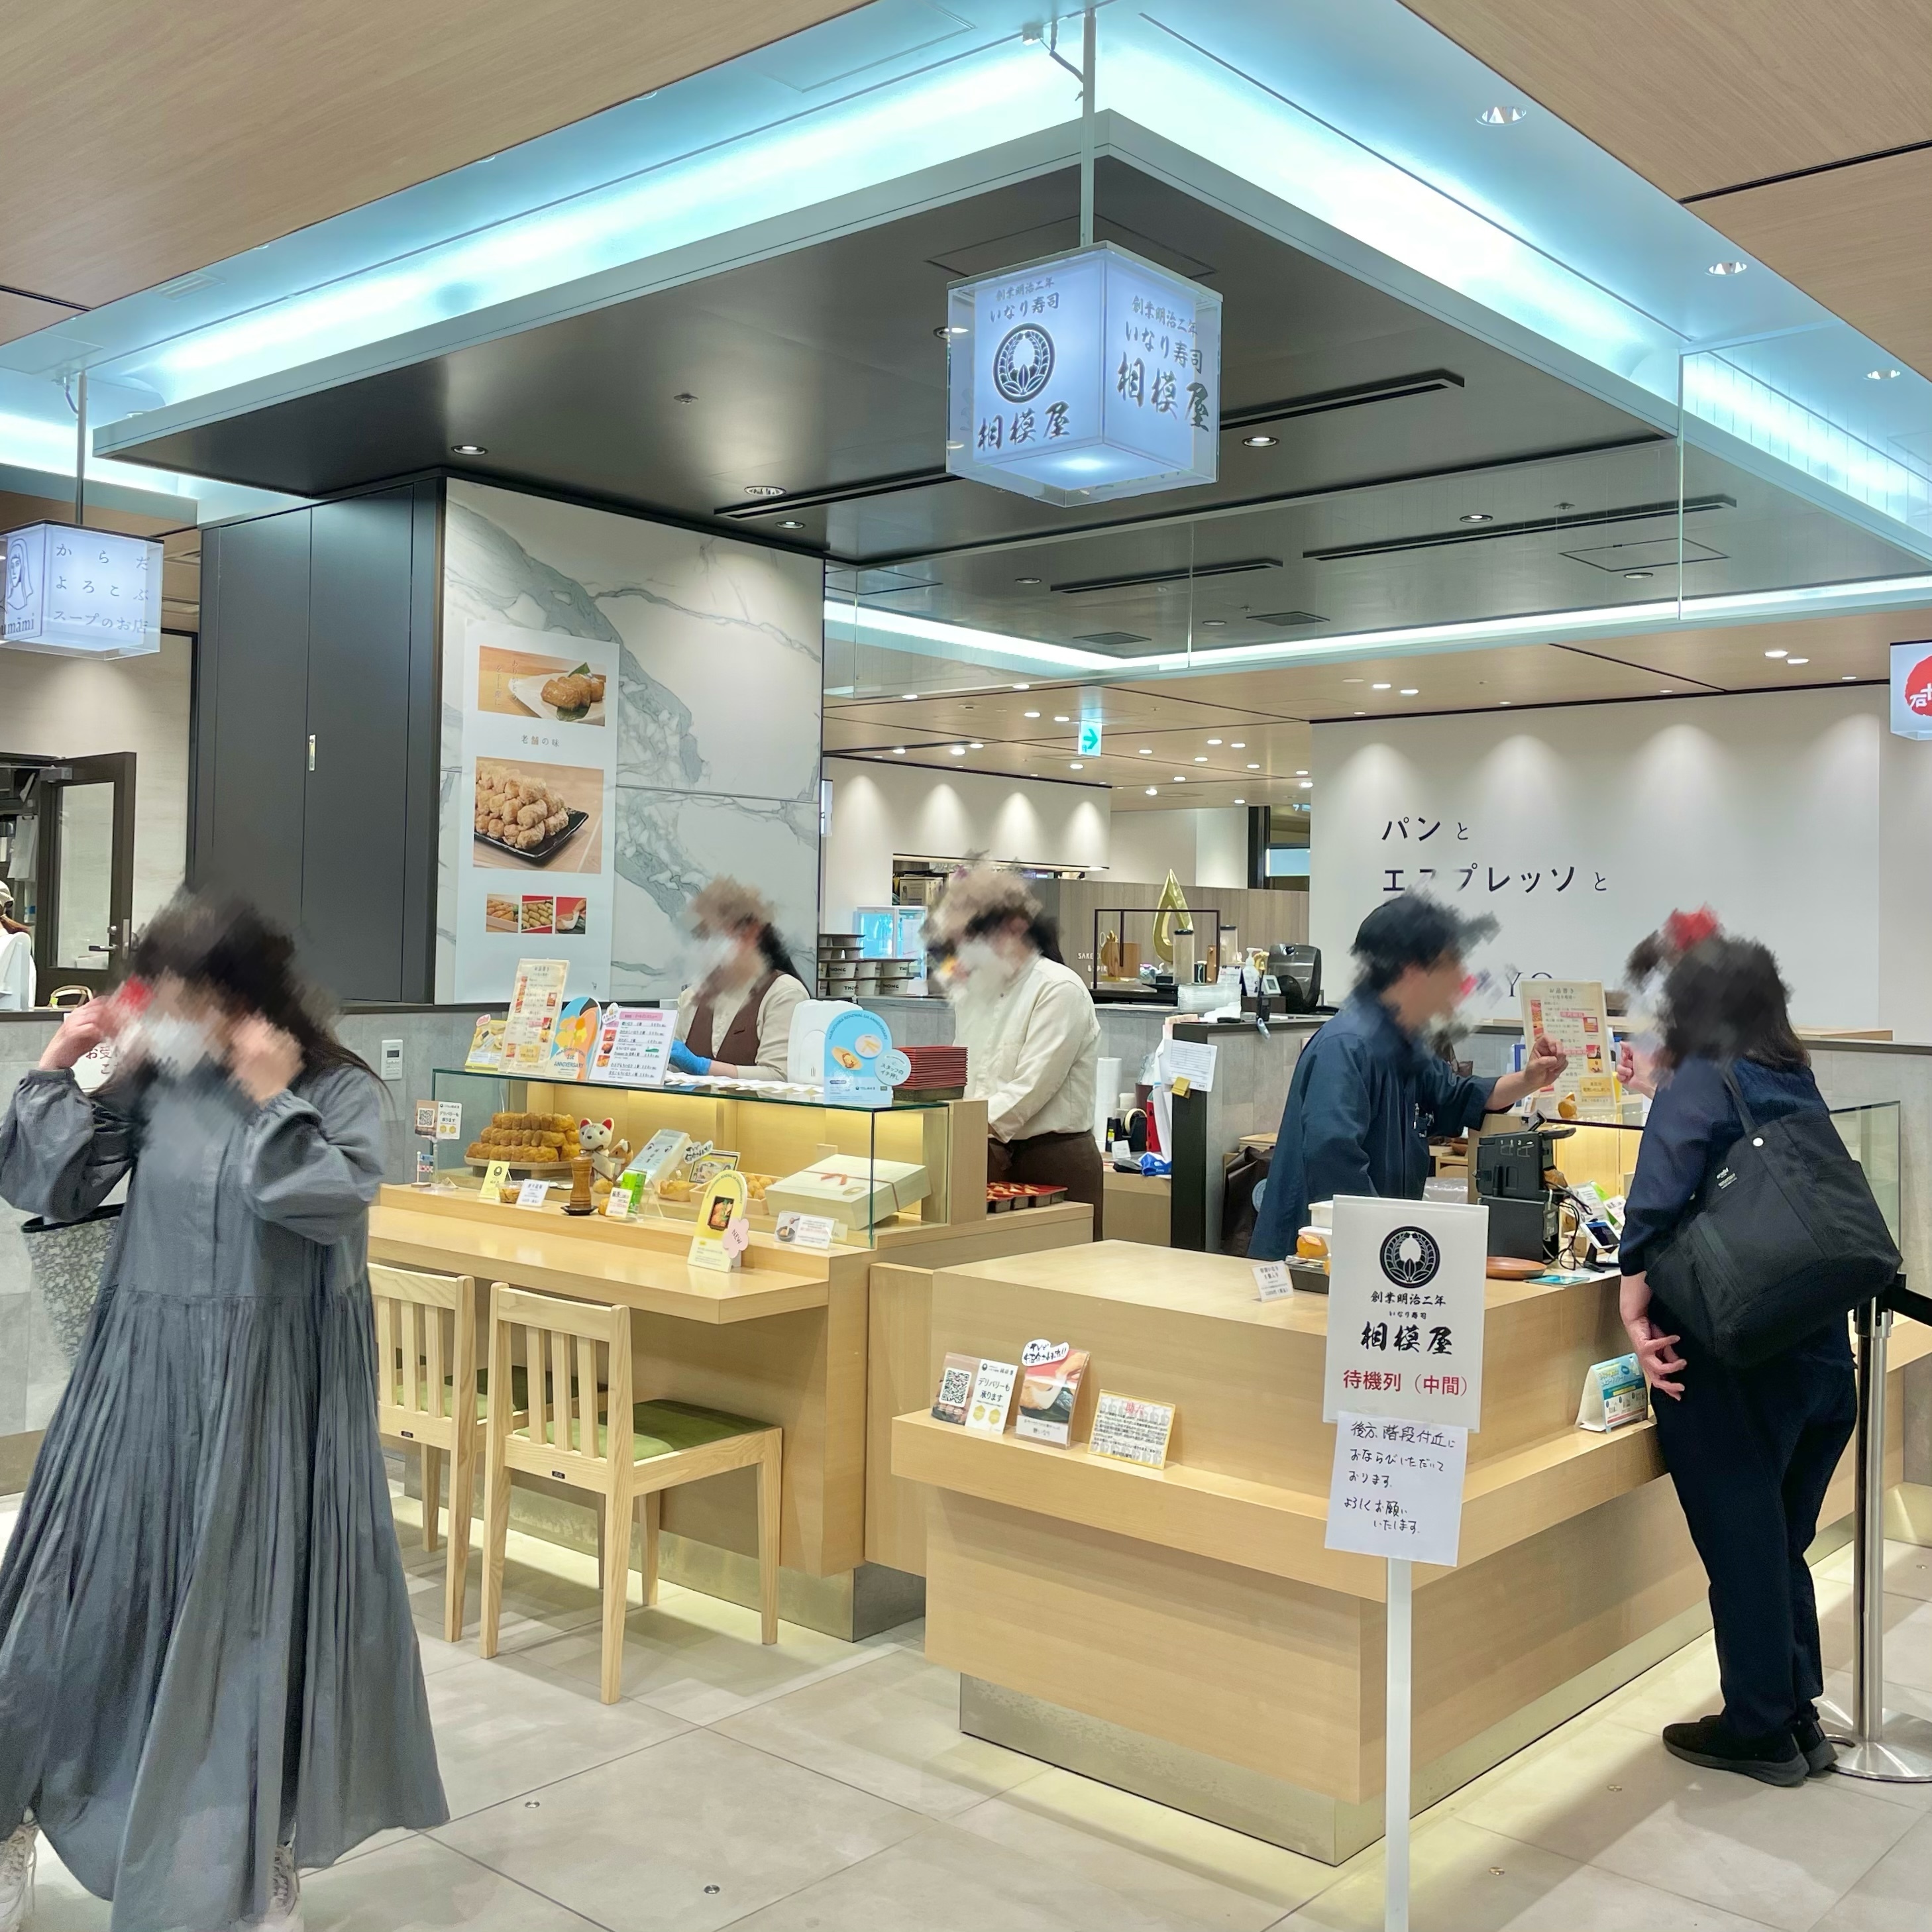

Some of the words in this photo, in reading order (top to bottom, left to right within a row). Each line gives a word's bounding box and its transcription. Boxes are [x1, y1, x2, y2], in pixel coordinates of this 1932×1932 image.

[996, 276, 1055, 301] 創業明治二年
[990, 292, 1060, 323] いなり寿司
[1132, 295, 1198, 335] 創業明治二年
[1125, 321, 1203, 374] いなり寿司
[1116, 351, 1209, 432] 相模屋
[977, 400, 1071, 451] 相模屋
[56, 576, 149, 602] よろこぶ
[53, 610, 148, 635] スープのお店
[521, 735, 560, 747] 老舗の味
[1381, 816, 1469, 842] パンと
[881, 1063, 904, 1075] スタッフの
[731, 1229, 742, 1245] NEW
[1371, 1291, 1446, 1307] 創業明治二年
[1389, 1311, 1427, 1320] いなり寿司
[1360, 1321, 1453, 1356] 相模屋
[978, 1377, 1010, 1392] デリバリーも
[981, 1390, 1004, 1403] 承ります
